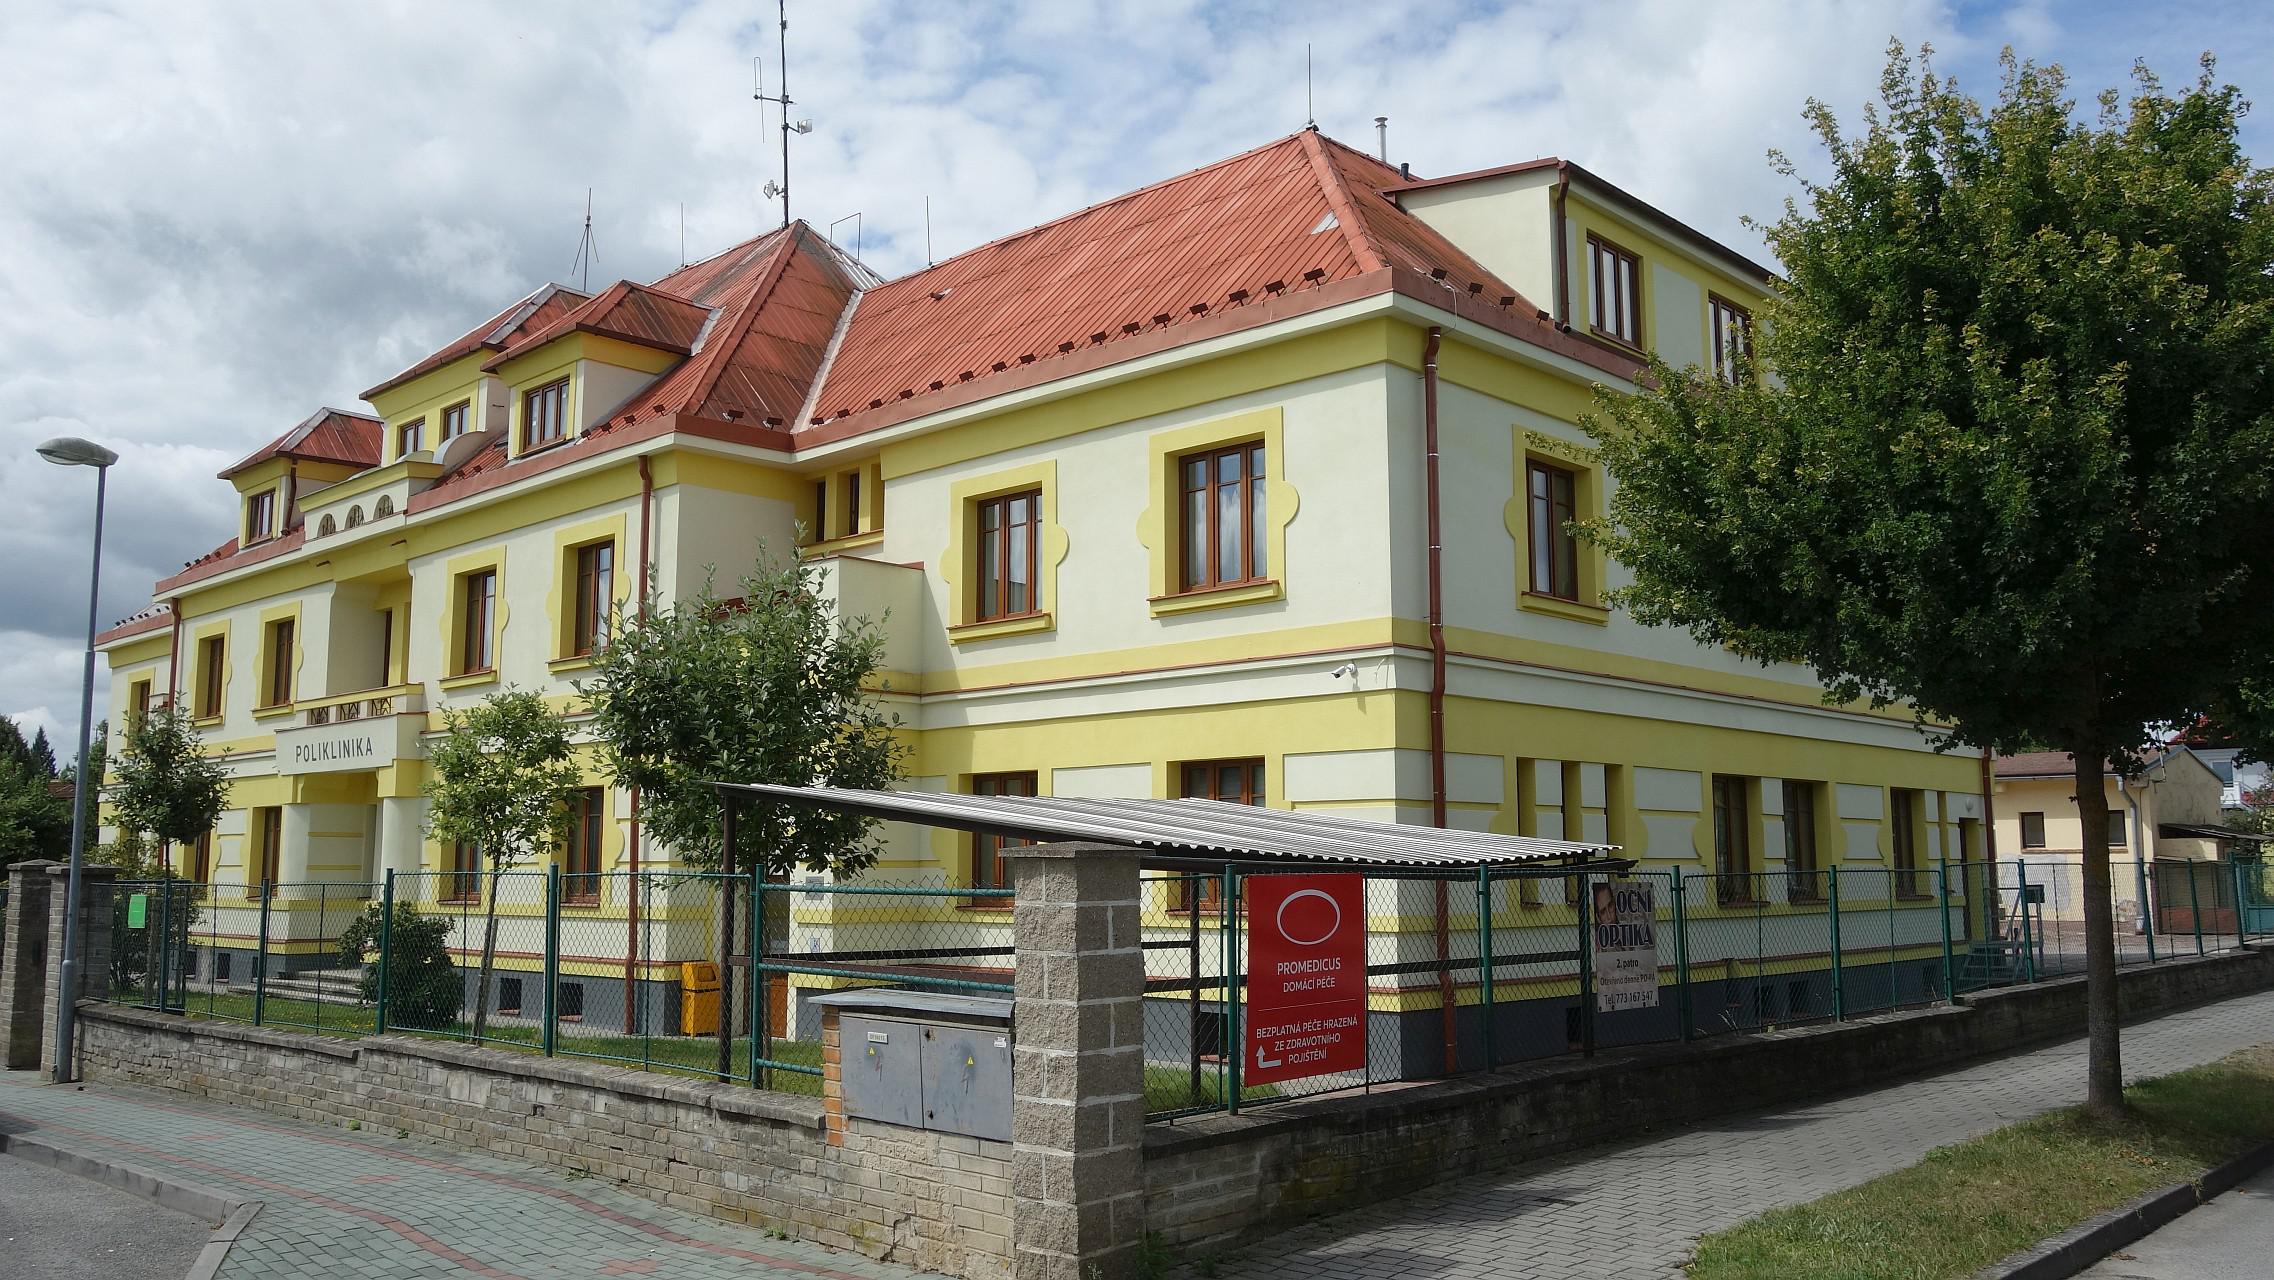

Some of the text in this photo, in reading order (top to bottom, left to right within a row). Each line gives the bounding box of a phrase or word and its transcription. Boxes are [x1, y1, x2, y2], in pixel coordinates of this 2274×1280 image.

[295, 736, 373, 763] POLIKLINIKA
[1598, 923, 1655, 949] OPTIKA
[1277, 957, 1341, 976] PROMEDICUS
[1623, 959, 1639, 969] patro
[1283, 976, 1336, 993] DOMÁCÍ PÉČE
[1630, 992, 1641, 1002] 167
[1256, 1014, 1358, 1038] BEZPLATNÁ PÉČE HRAZENÁ
[1274, 1032, 1341, 1052] ZE ZDRAVOTNÍHO
[1288, 1047, 1327, 1064] POJIŠTĚNÍ
